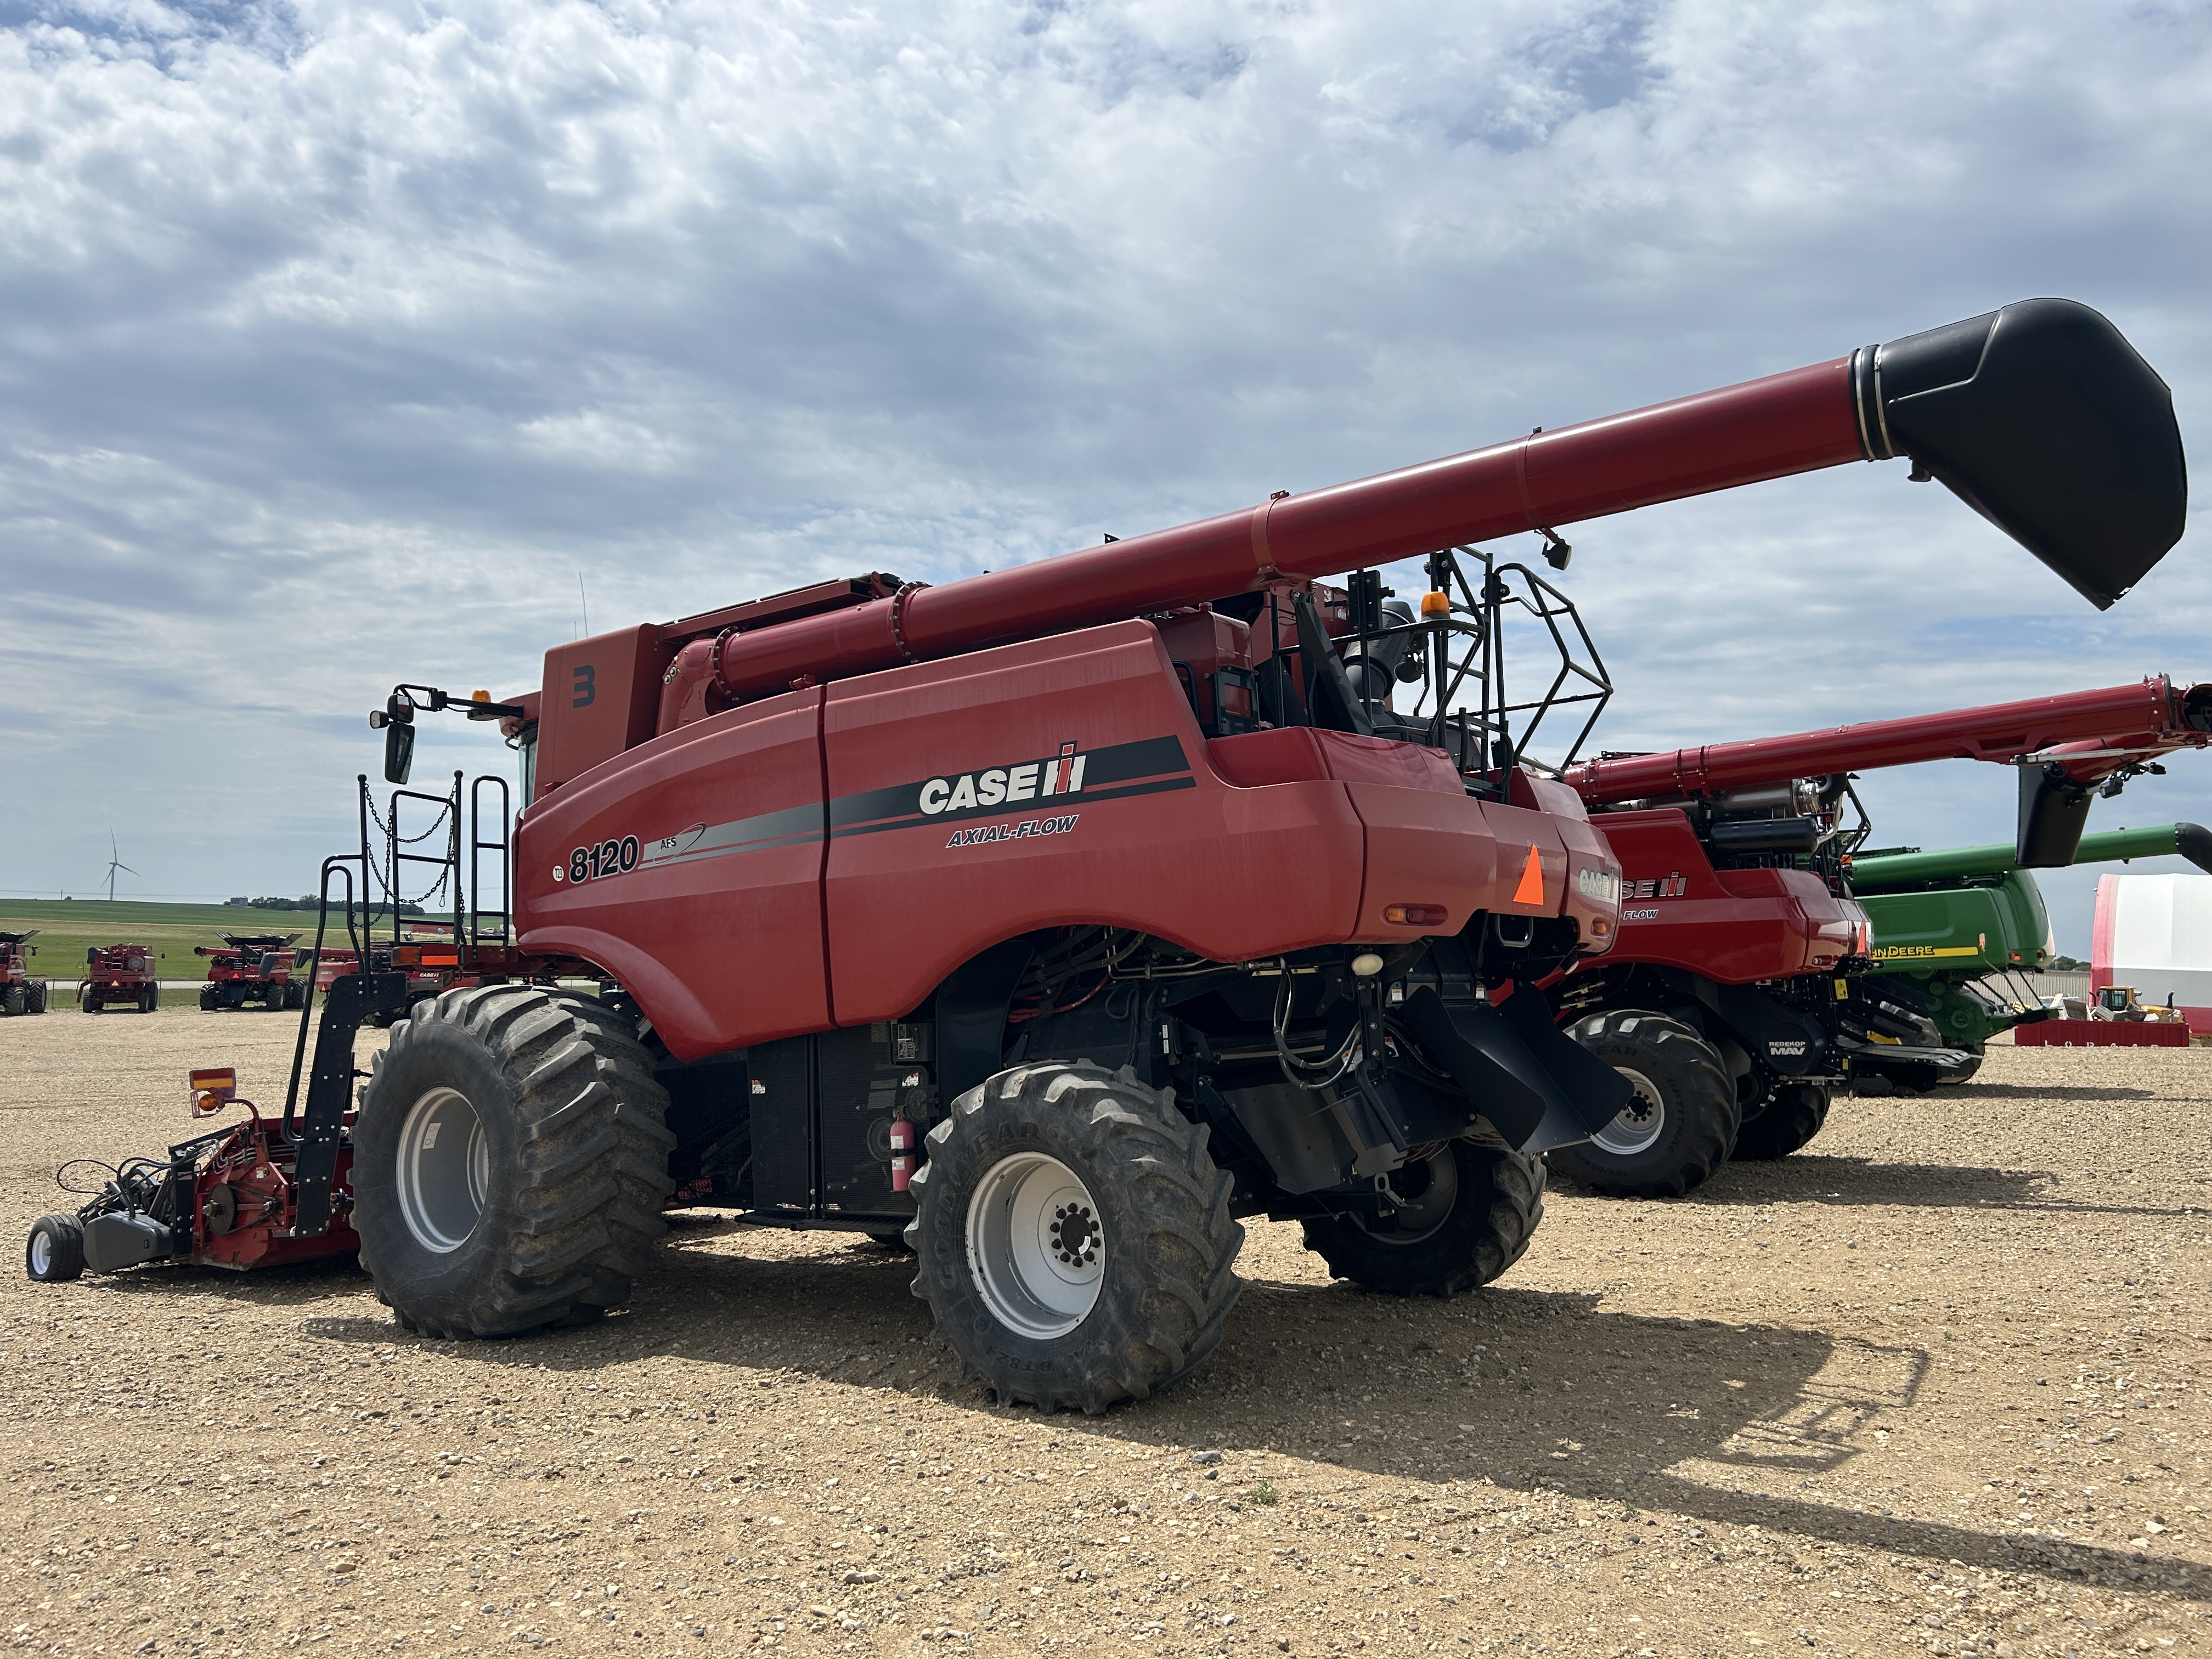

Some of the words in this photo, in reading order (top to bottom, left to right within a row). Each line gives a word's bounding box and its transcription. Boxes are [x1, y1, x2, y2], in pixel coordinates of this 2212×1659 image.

[573, 664, 596, 708] 3
[919, 763, 1039, 815] CASE
[660, 837, 677, 850] AFS
[945, 814, 1080, 848] AXIAL-FLOW
[569, 834, 640, 884] 8120
[1579, 867, 1608, 898] CASE
[1888, 945, 1933, 956] DEERE
